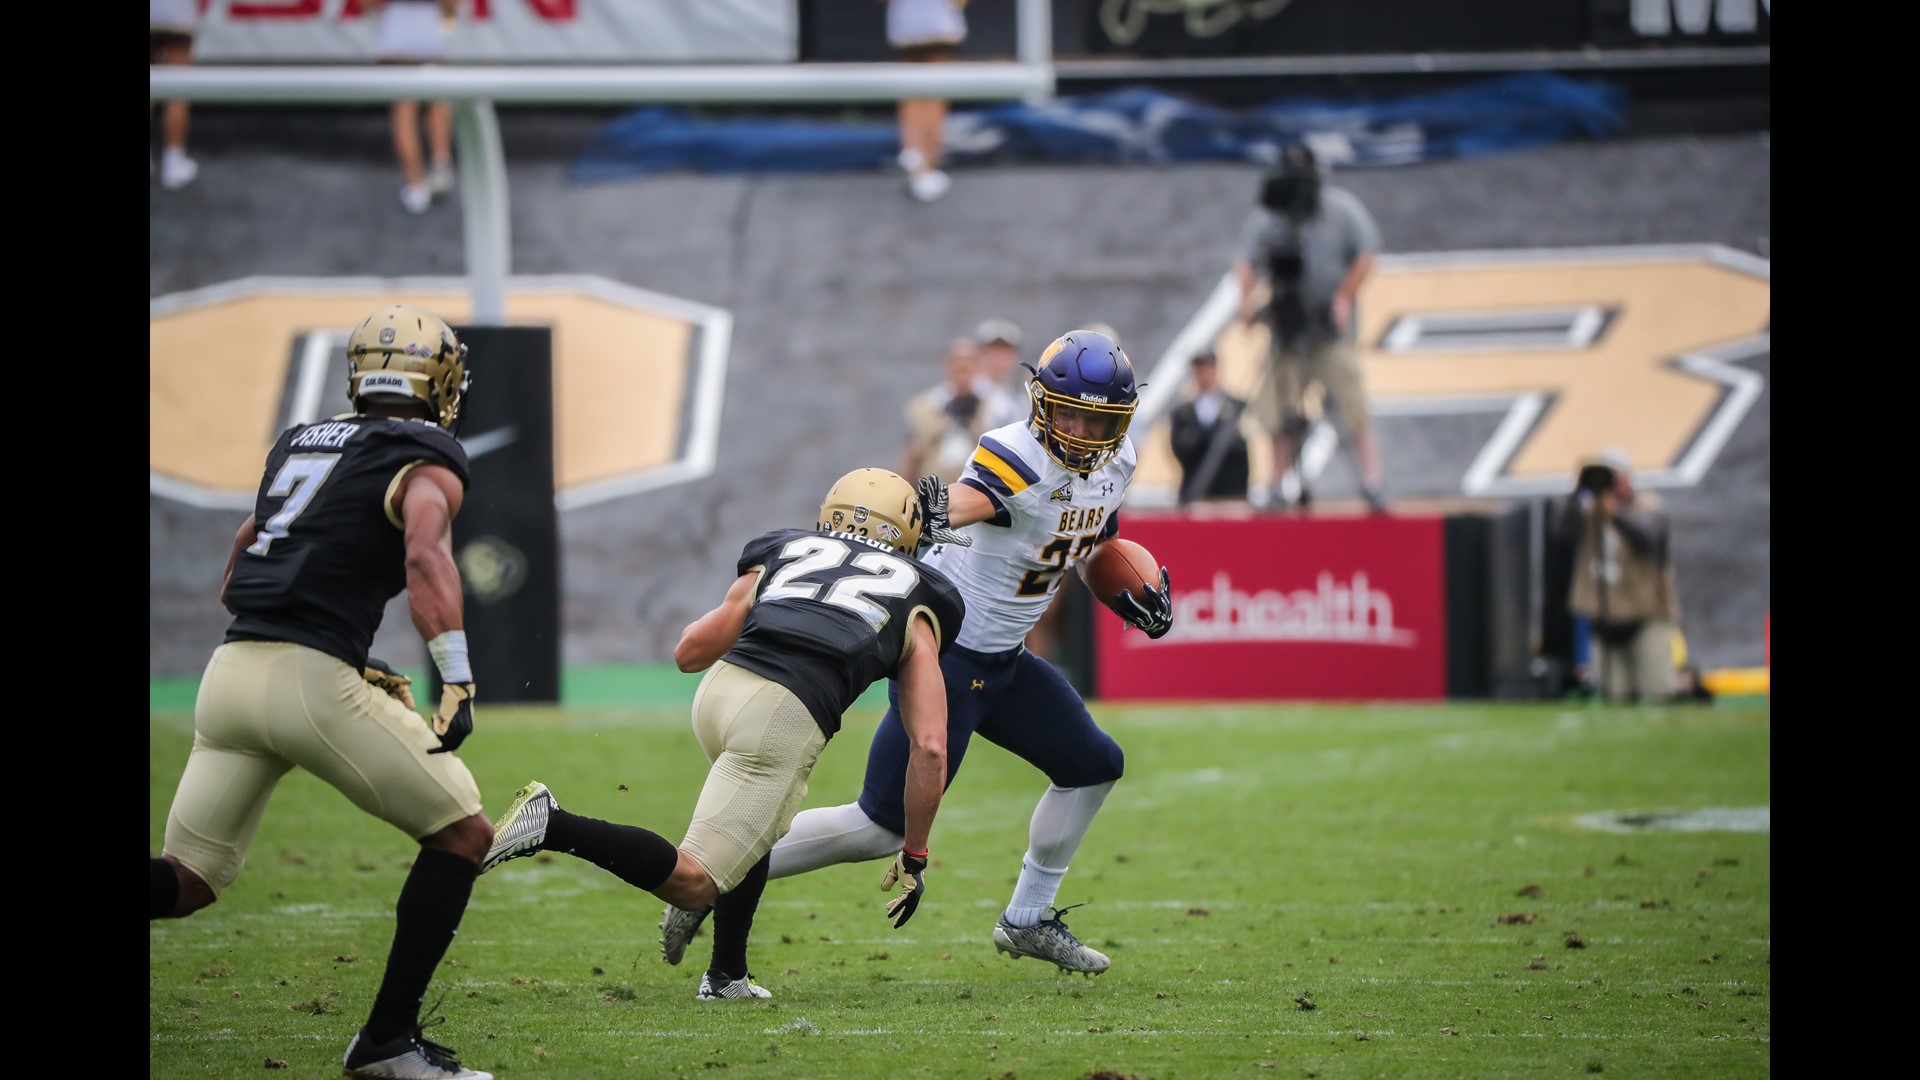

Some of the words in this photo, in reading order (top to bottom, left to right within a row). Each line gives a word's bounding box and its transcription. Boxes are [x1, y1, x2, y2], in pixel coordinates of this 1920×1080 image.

[365, 378, 402, 387] COLORADO
[1080, 393, 1108, 404] Riddell
[290, 422, 360, 447] FISHER
[246, 452, 343, 556] 7
[1057, 506, 1104, 532] BEARS
[759, 536, 920, 633] 22
[1172, 569, 1394, 640] chealth
